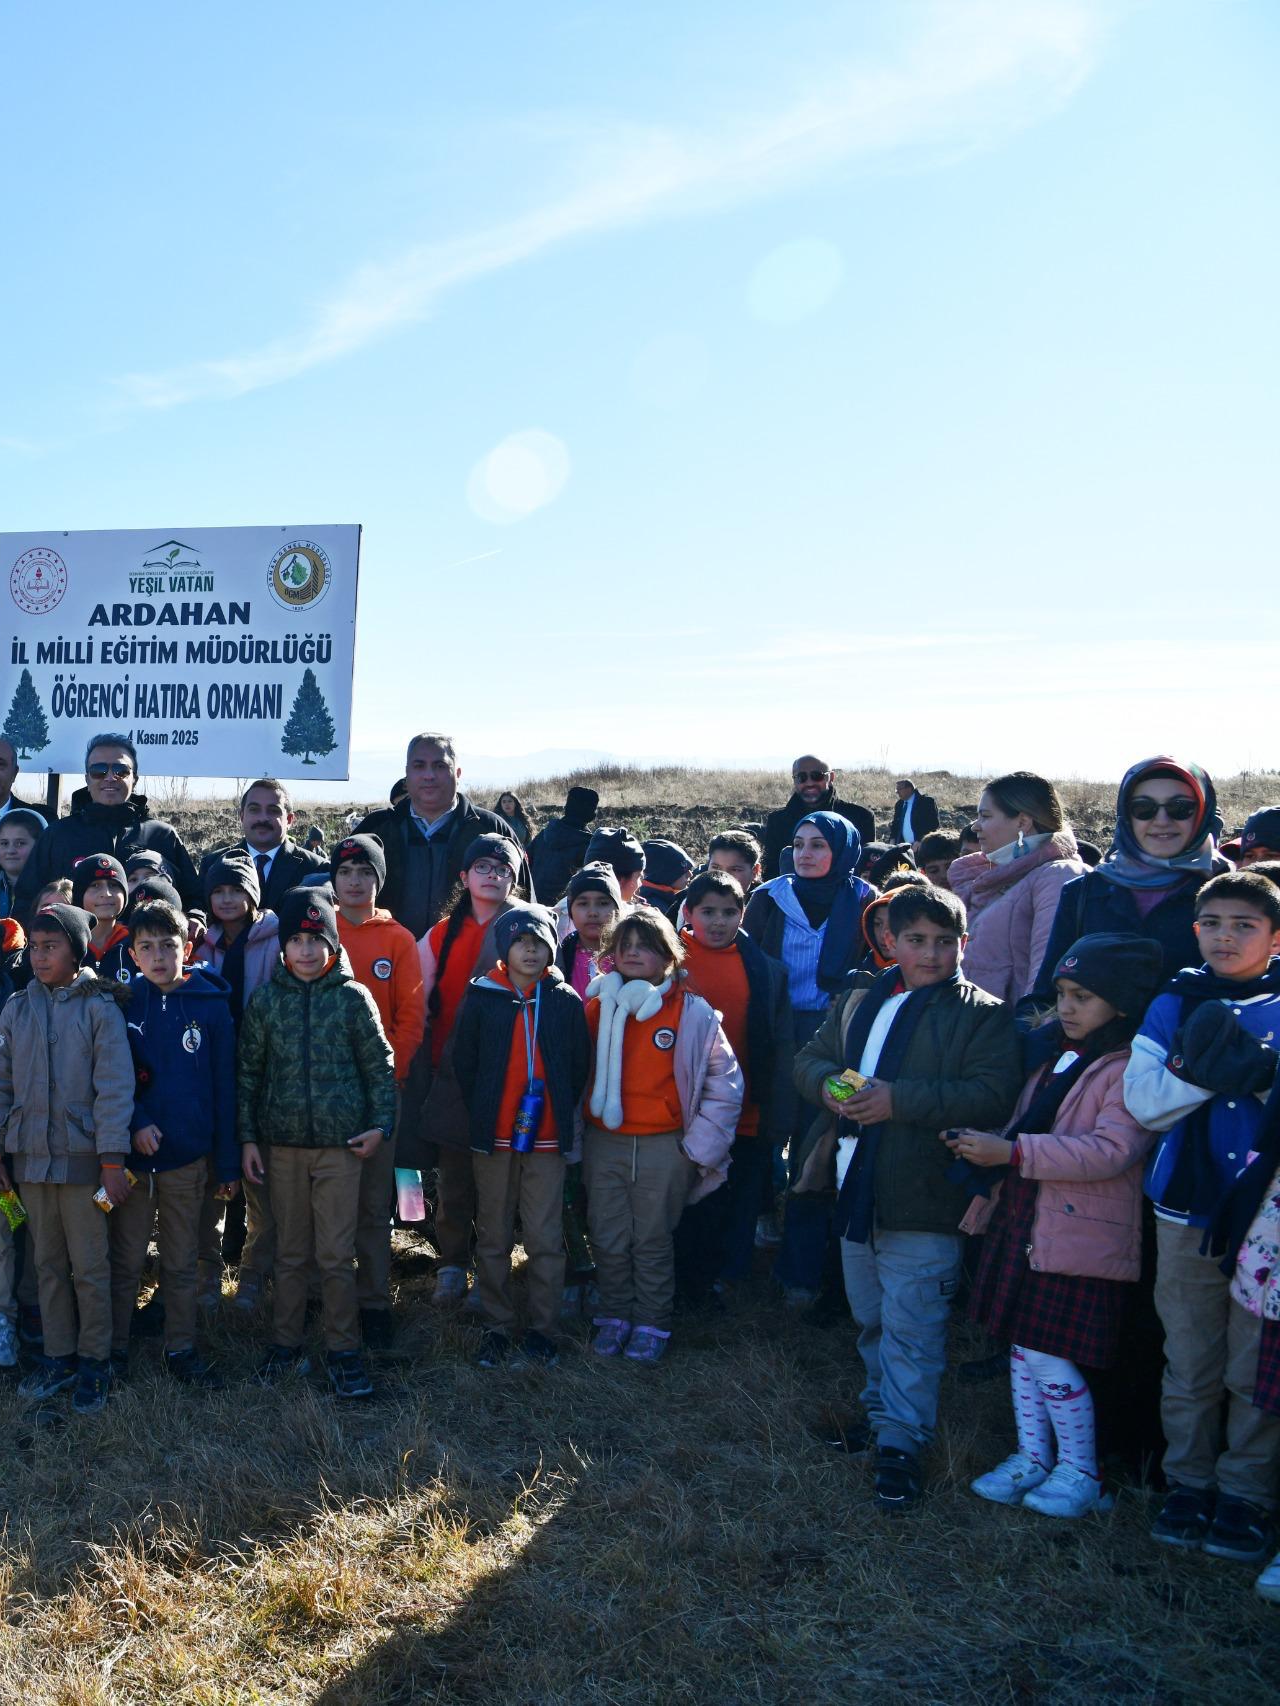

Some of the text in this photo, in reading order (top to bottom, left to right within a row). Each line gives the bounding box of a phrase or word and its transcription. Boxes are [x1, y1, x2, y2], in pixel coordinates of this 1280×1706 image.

[168, 575, 214, 593] VATAN
[88, 601, 251, 627] ARDAHAN
[11, 633, 332, 665] İL MİLLİ EĞİTİM MÜDÜRLÜĞÜ
[51, 673, 283, 720] ÖĞRENCİ HATIRA ORMANI
[136, 729, 169, 745] Kasım
[171, 729, 199, 746] 2025
